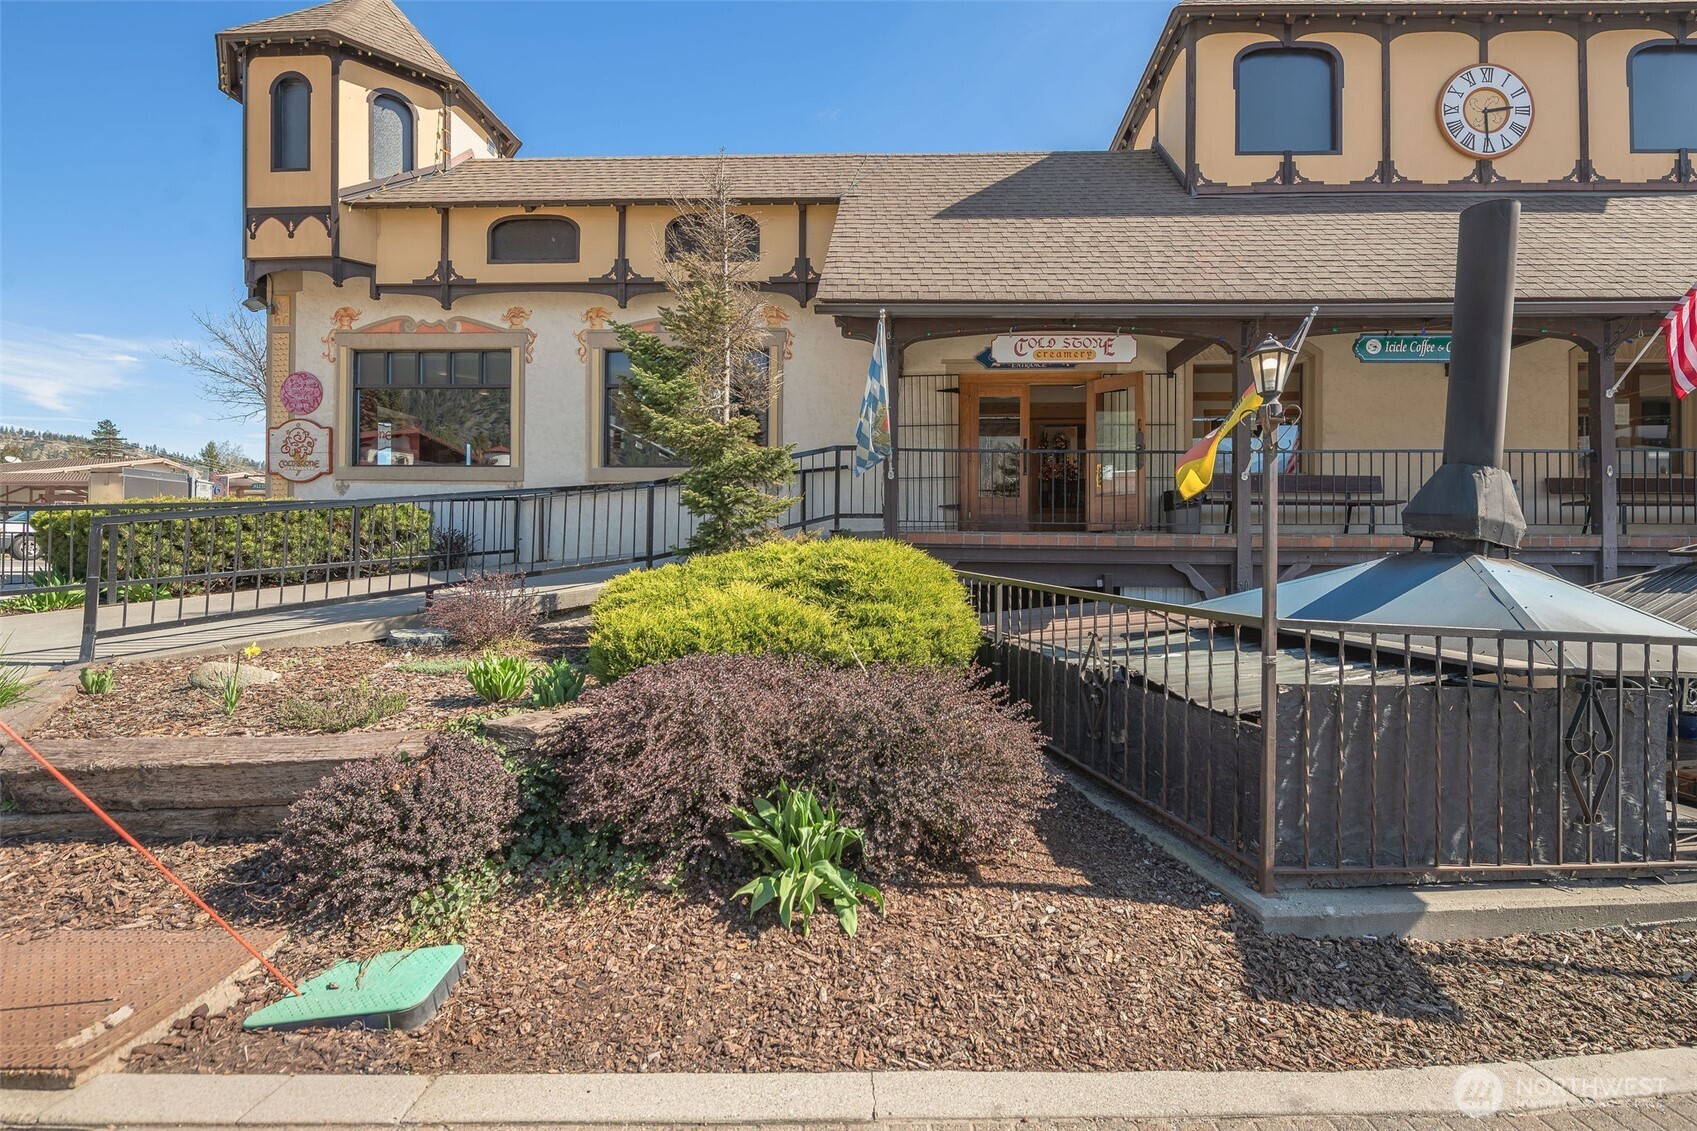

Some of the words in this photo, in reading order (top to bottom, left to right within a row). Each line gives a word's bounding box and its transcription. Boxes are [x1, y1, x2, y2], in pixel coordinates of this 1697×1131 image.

[1479, 68, 1494, 82] XII
[1013, 337, 1056, 357] COLD
[1063, 337, 1115, 356] STONE
[1385, 340, 1407, 352] Icicle
[1409, 339, 1435, 356] Coffee
[1036, 351, 1092, 359] creamery
